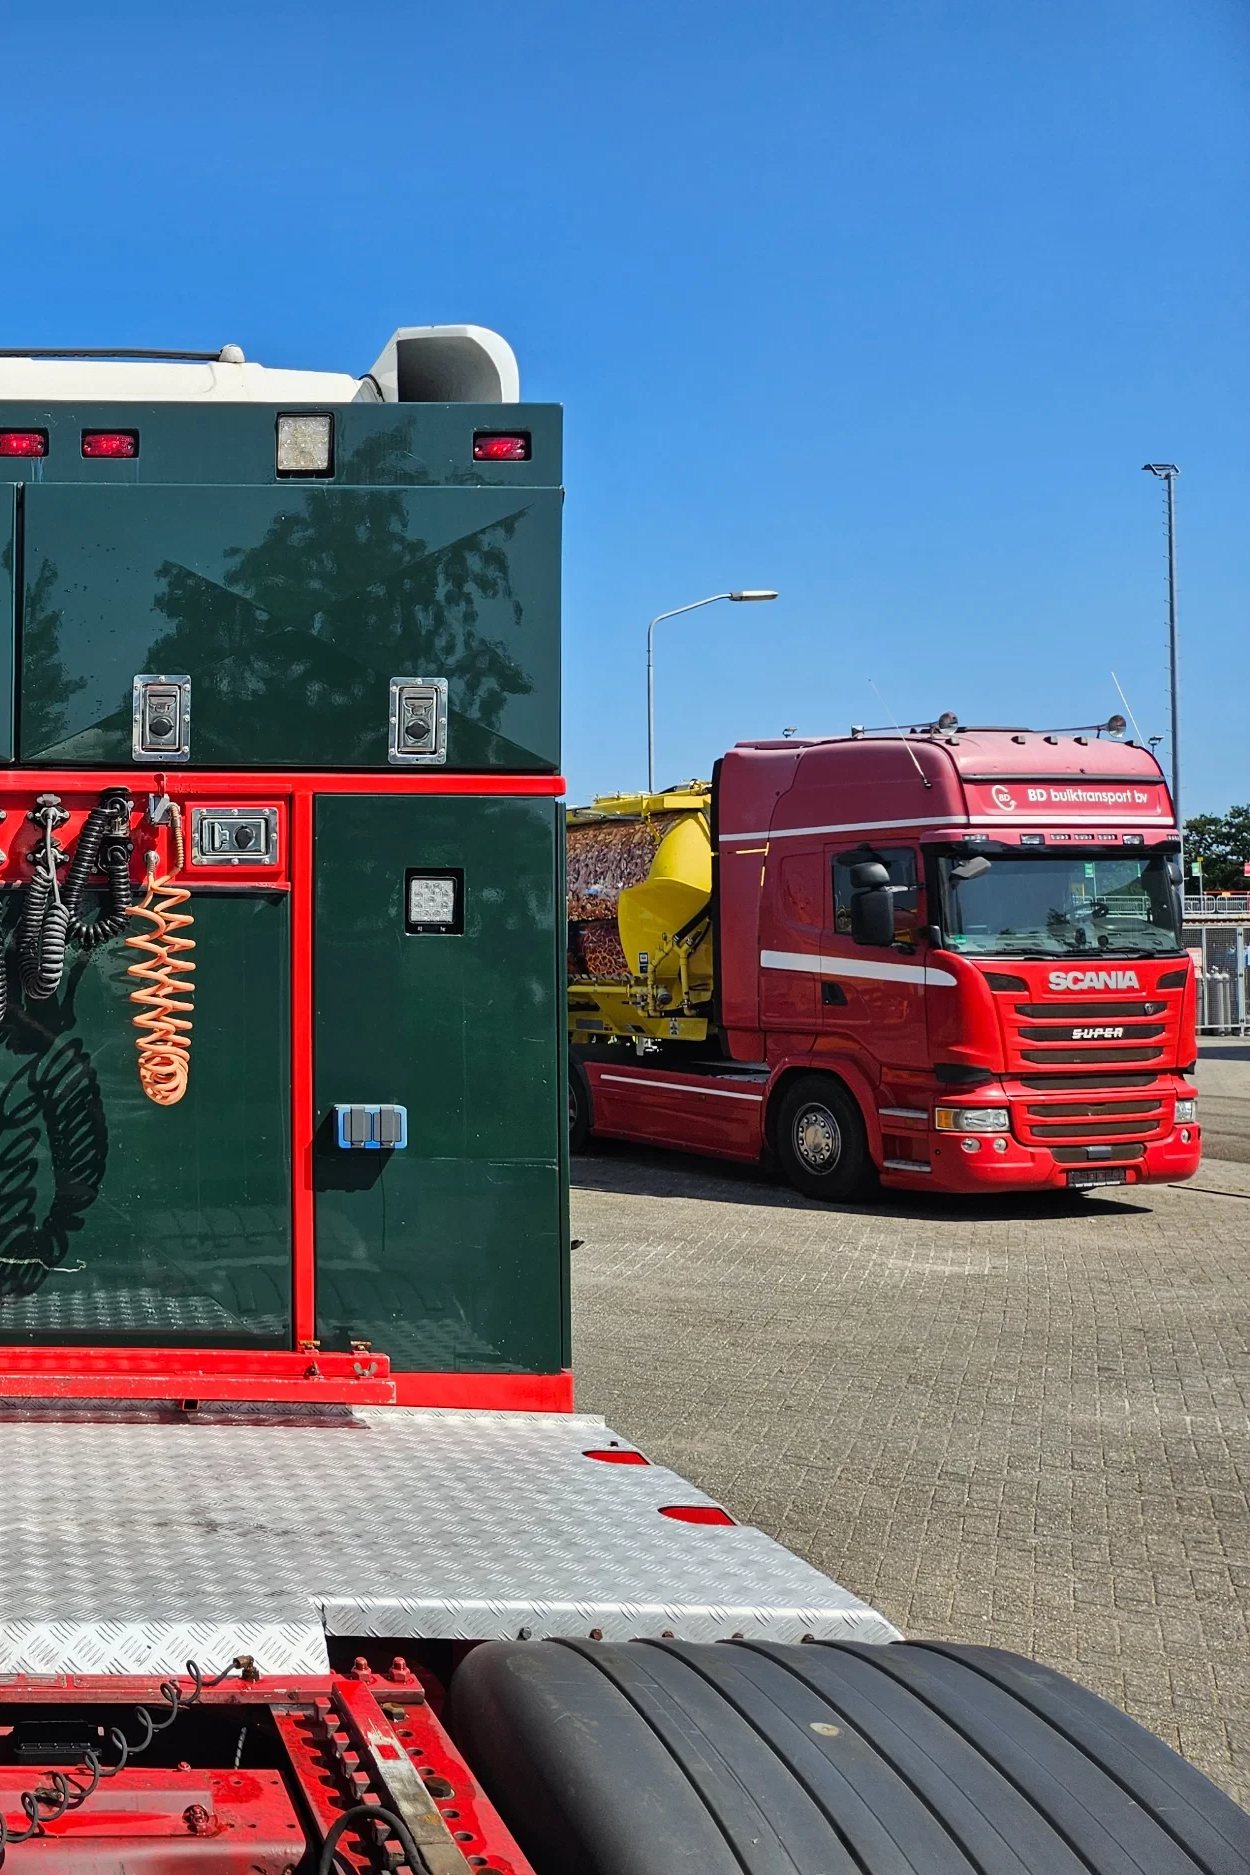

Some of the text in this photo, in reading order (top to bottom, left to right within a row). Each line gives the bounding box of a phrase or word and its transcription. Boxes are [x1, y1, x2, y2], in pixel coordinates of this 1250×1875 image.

[998, 793, 1011, 802] BD
[1027, 788, 1148, 805] BD bulktransport bv
[1048, 970, 1140, 991] SCANIA
[1071, 1027, 1124, 1039] SUPER
